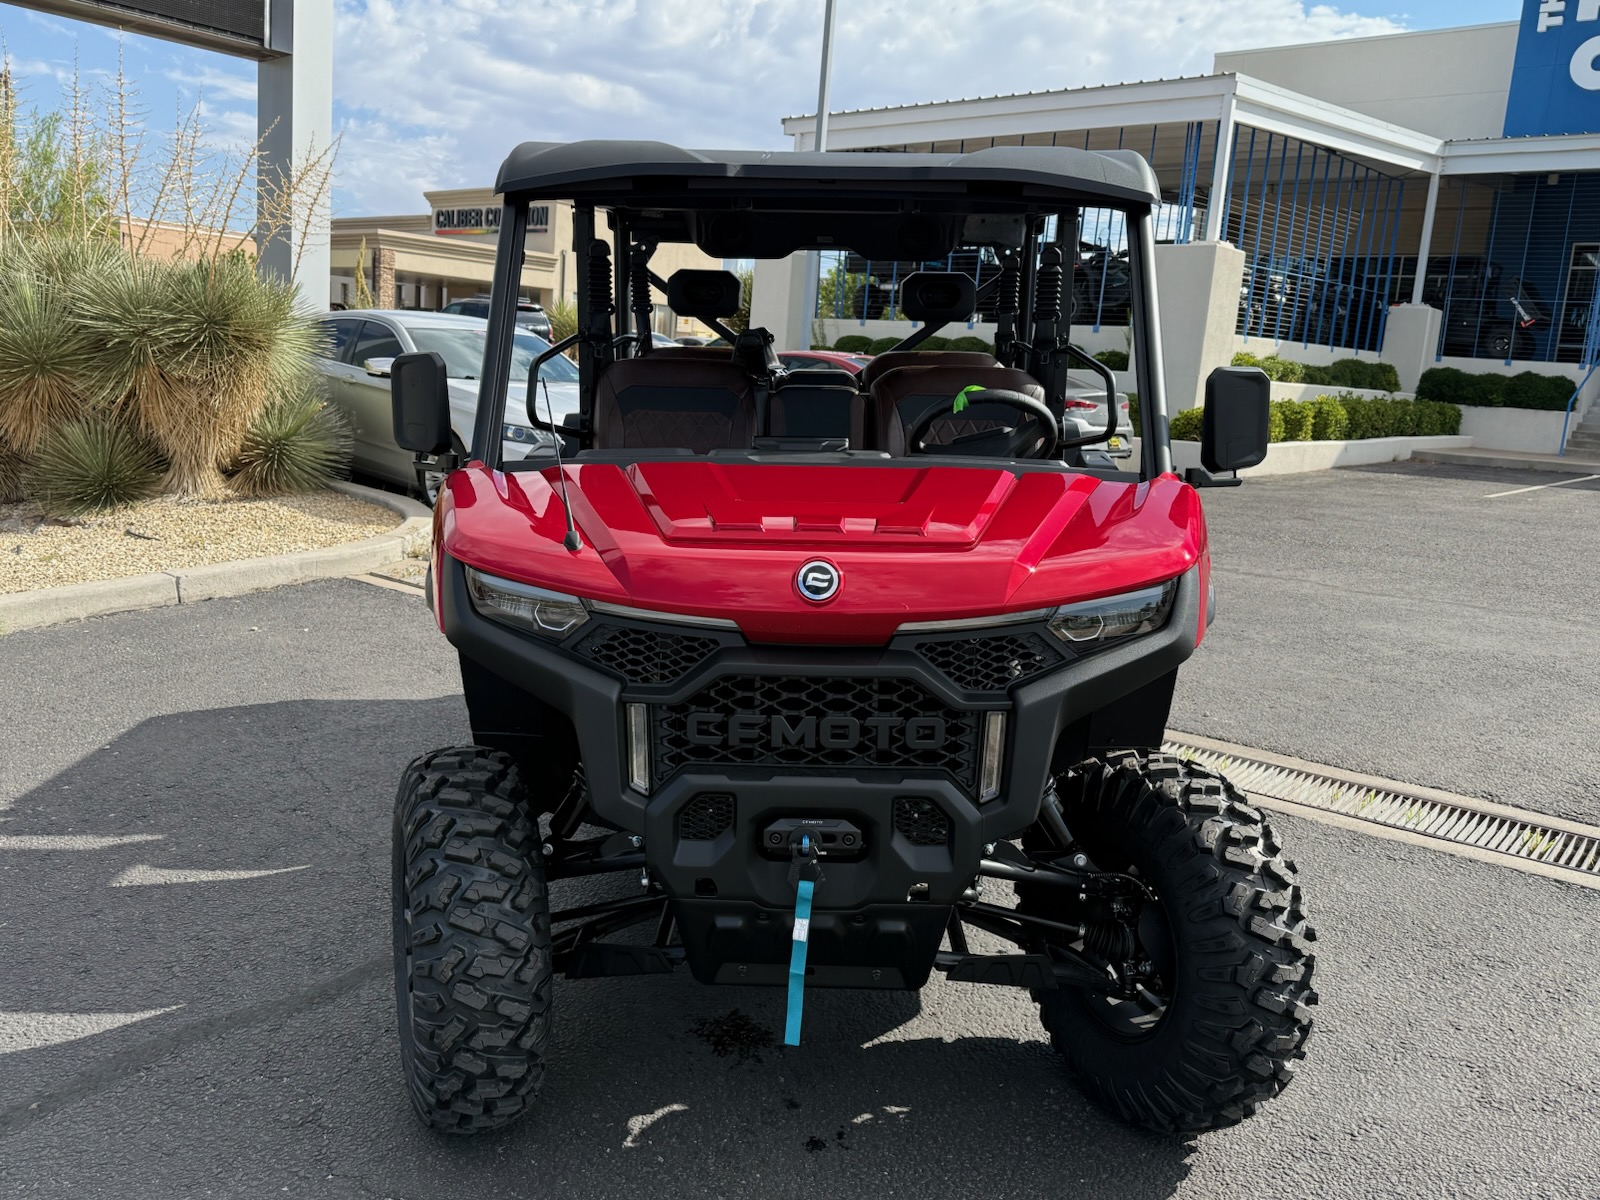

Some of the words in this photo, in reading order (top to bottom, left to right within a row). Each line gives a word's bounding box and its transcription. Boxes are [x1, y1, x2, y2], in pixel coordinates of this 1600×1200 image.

[435, 208, 482, 228] CALIBER
[484, 206, 549, 227] COION
[686, 712, 946, 750] CFMOTO
